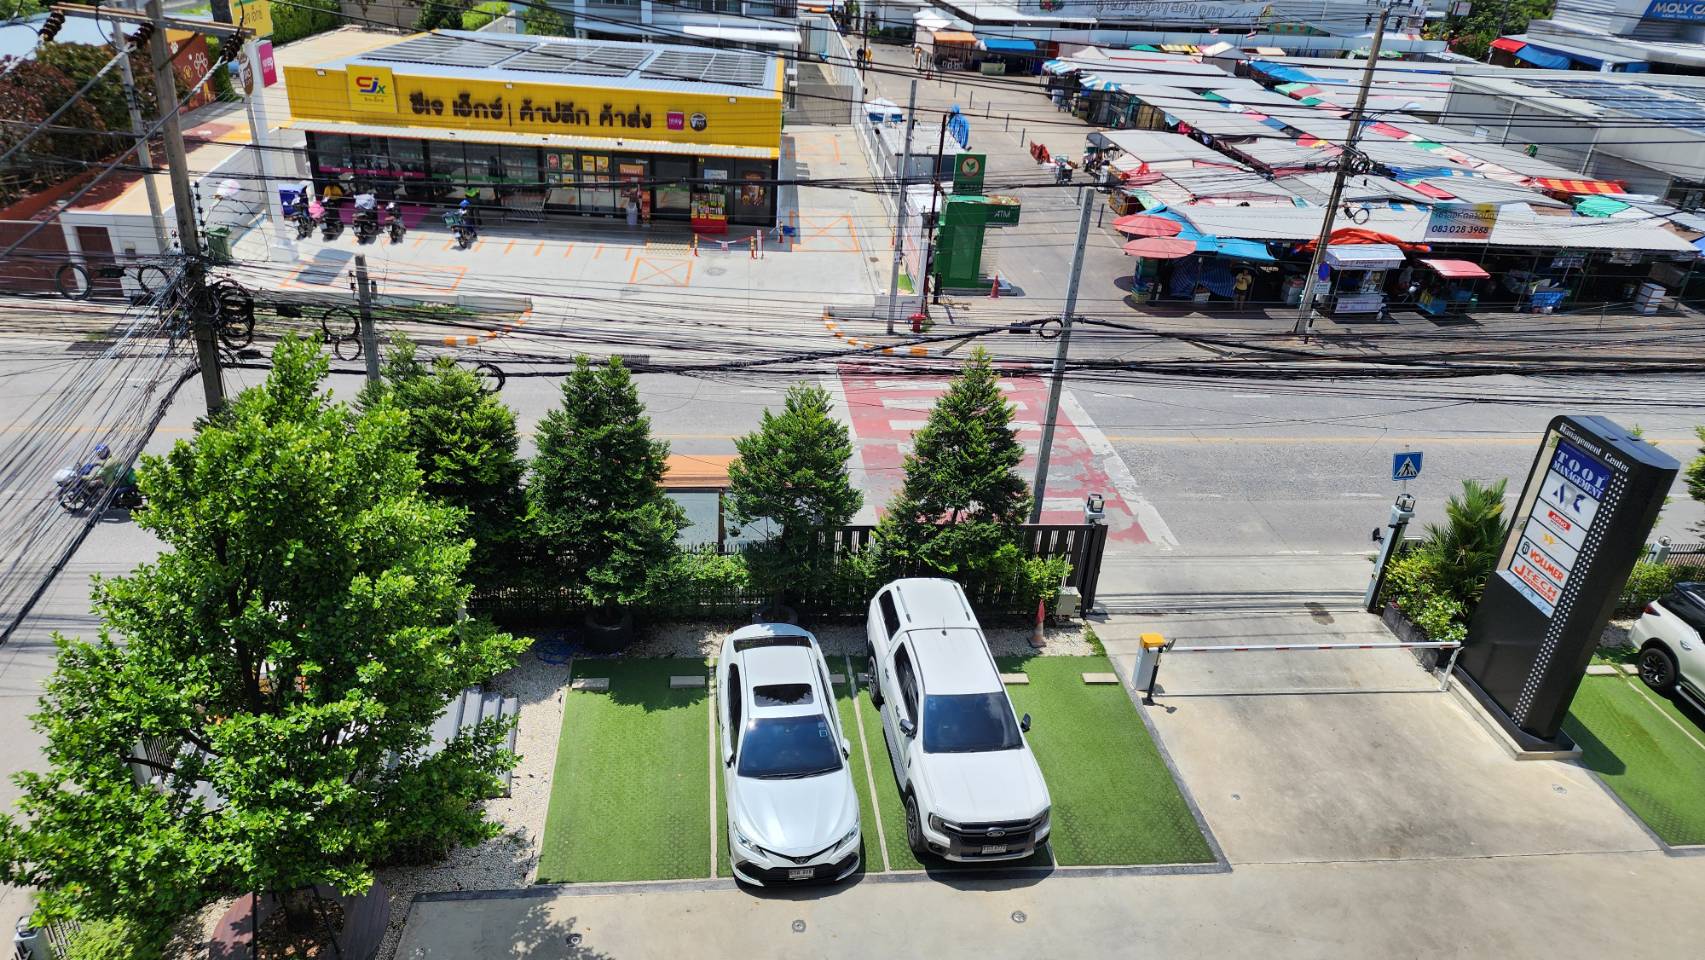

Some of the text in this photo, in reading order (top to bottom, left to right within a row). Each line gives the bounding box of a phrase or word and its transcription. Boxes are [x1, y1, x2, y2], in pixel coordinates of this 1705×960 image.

[1653, 3, 1693, 13] MOLY
[410, 90, 444, 115] ซีเจ
[520, 98, 590, 126] ค้าปลีก
[600, 103, 652, 128] ค้าส่ง
[994, 210, 1011, 218] ATM
[1432, 225, 1448, 233] 083
[1560, 424, 1630, 473] Management Center
[1552, 460, 1604, 499] MANAGEMENT
[1558, 449, 1606, 492] TOOL
[1530, 549, 1564, 582] VOLLMER
